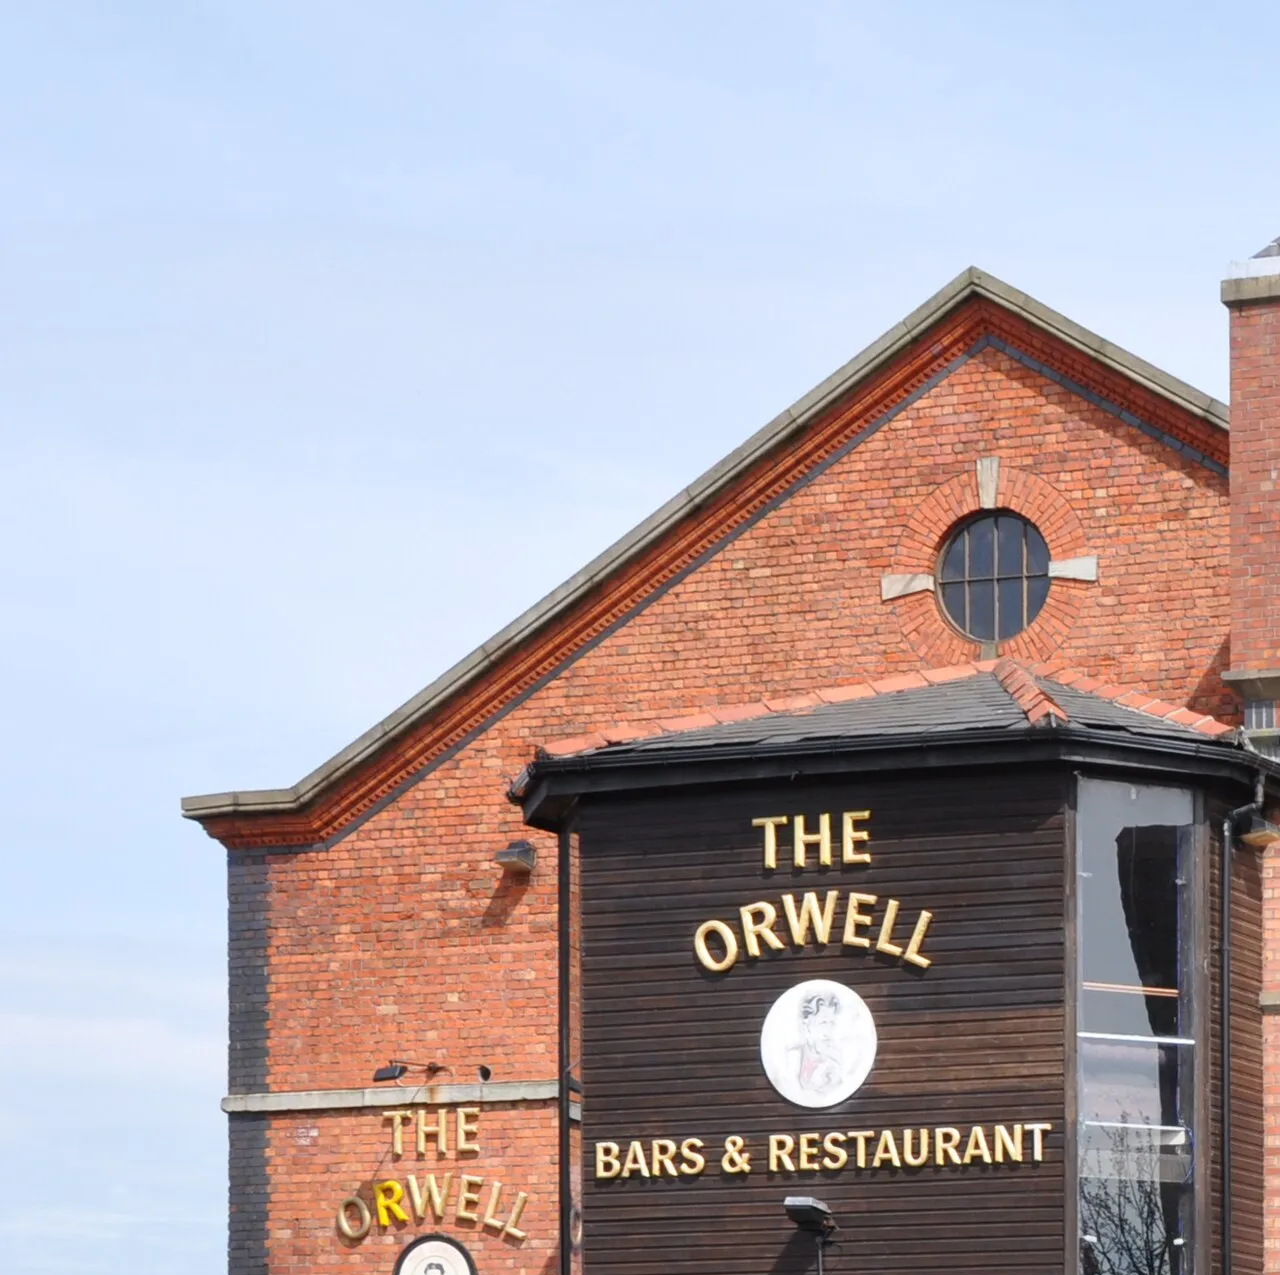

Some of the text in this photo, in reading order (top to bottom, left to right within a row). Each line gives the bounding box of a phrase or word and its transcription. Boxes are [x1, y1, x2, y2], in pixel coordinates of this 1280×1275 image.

[752, 810, 872, 869] THE
[693, 889, 934, 972] ORWELL
[383, 1107, 481, 1156] THE
[595, 1123, 1053, 1179] BARS & RESTAURANT
[336, 1172, 528, 1240] ORWELL
